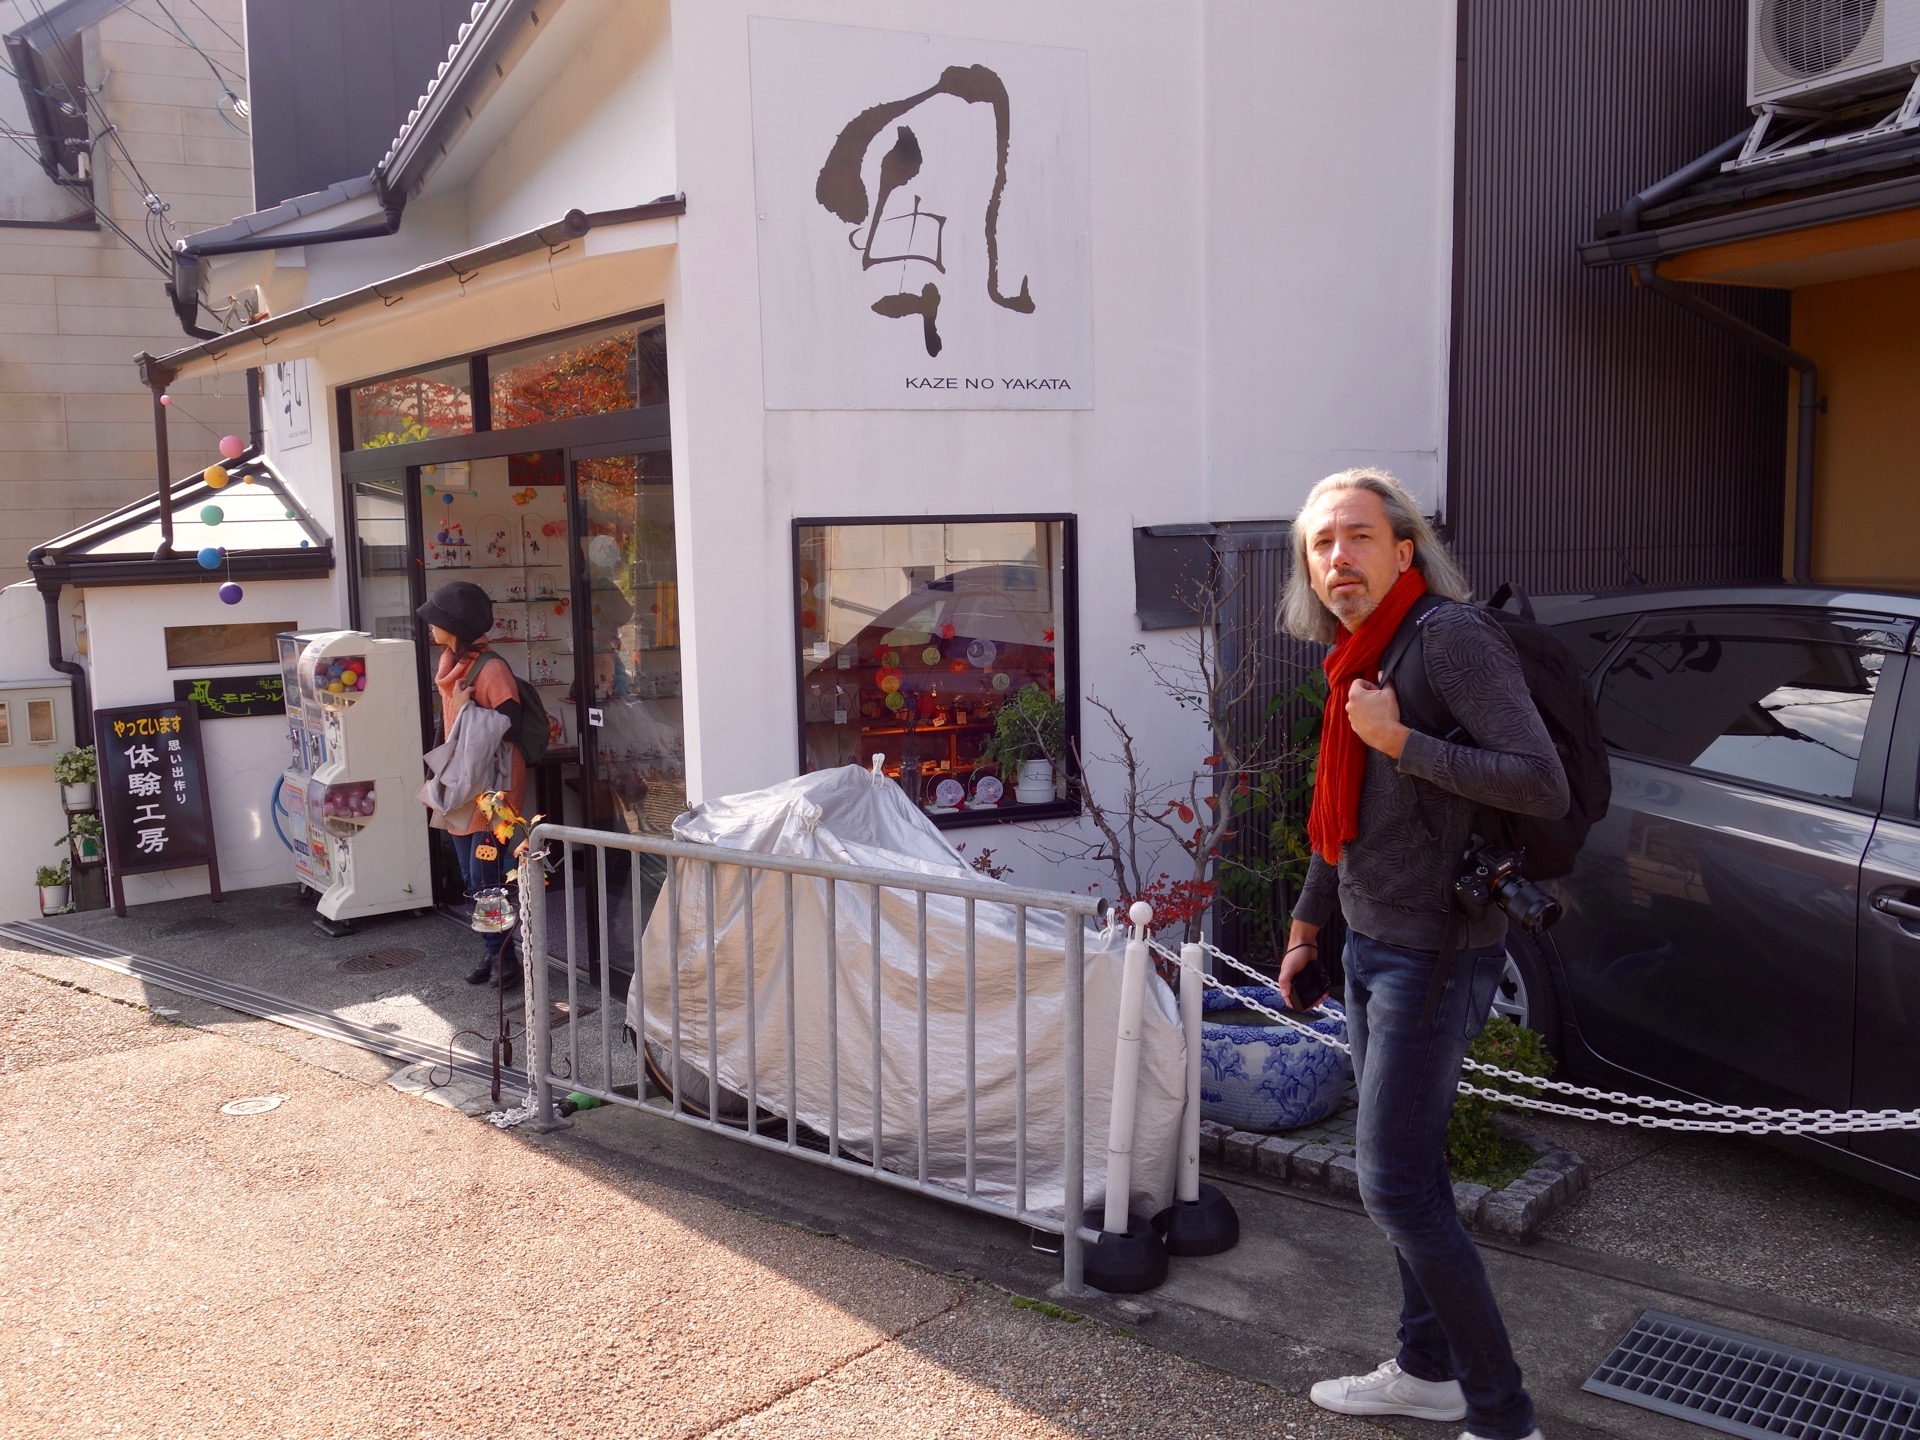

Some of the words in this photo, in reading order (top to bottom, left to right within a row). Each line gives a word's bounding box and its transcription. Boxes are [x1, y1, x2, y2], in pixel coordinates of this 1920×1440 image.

[905, 377, 958, 389] KAZE
[965, 378, 994, 390] NO
[1001, 378, 1071, 390] YAKATA
[113, 715, 182, 738] やっています
[168, 739, 187, 805] 思い出作り
[124, 743, 169, 854] 体験工房
